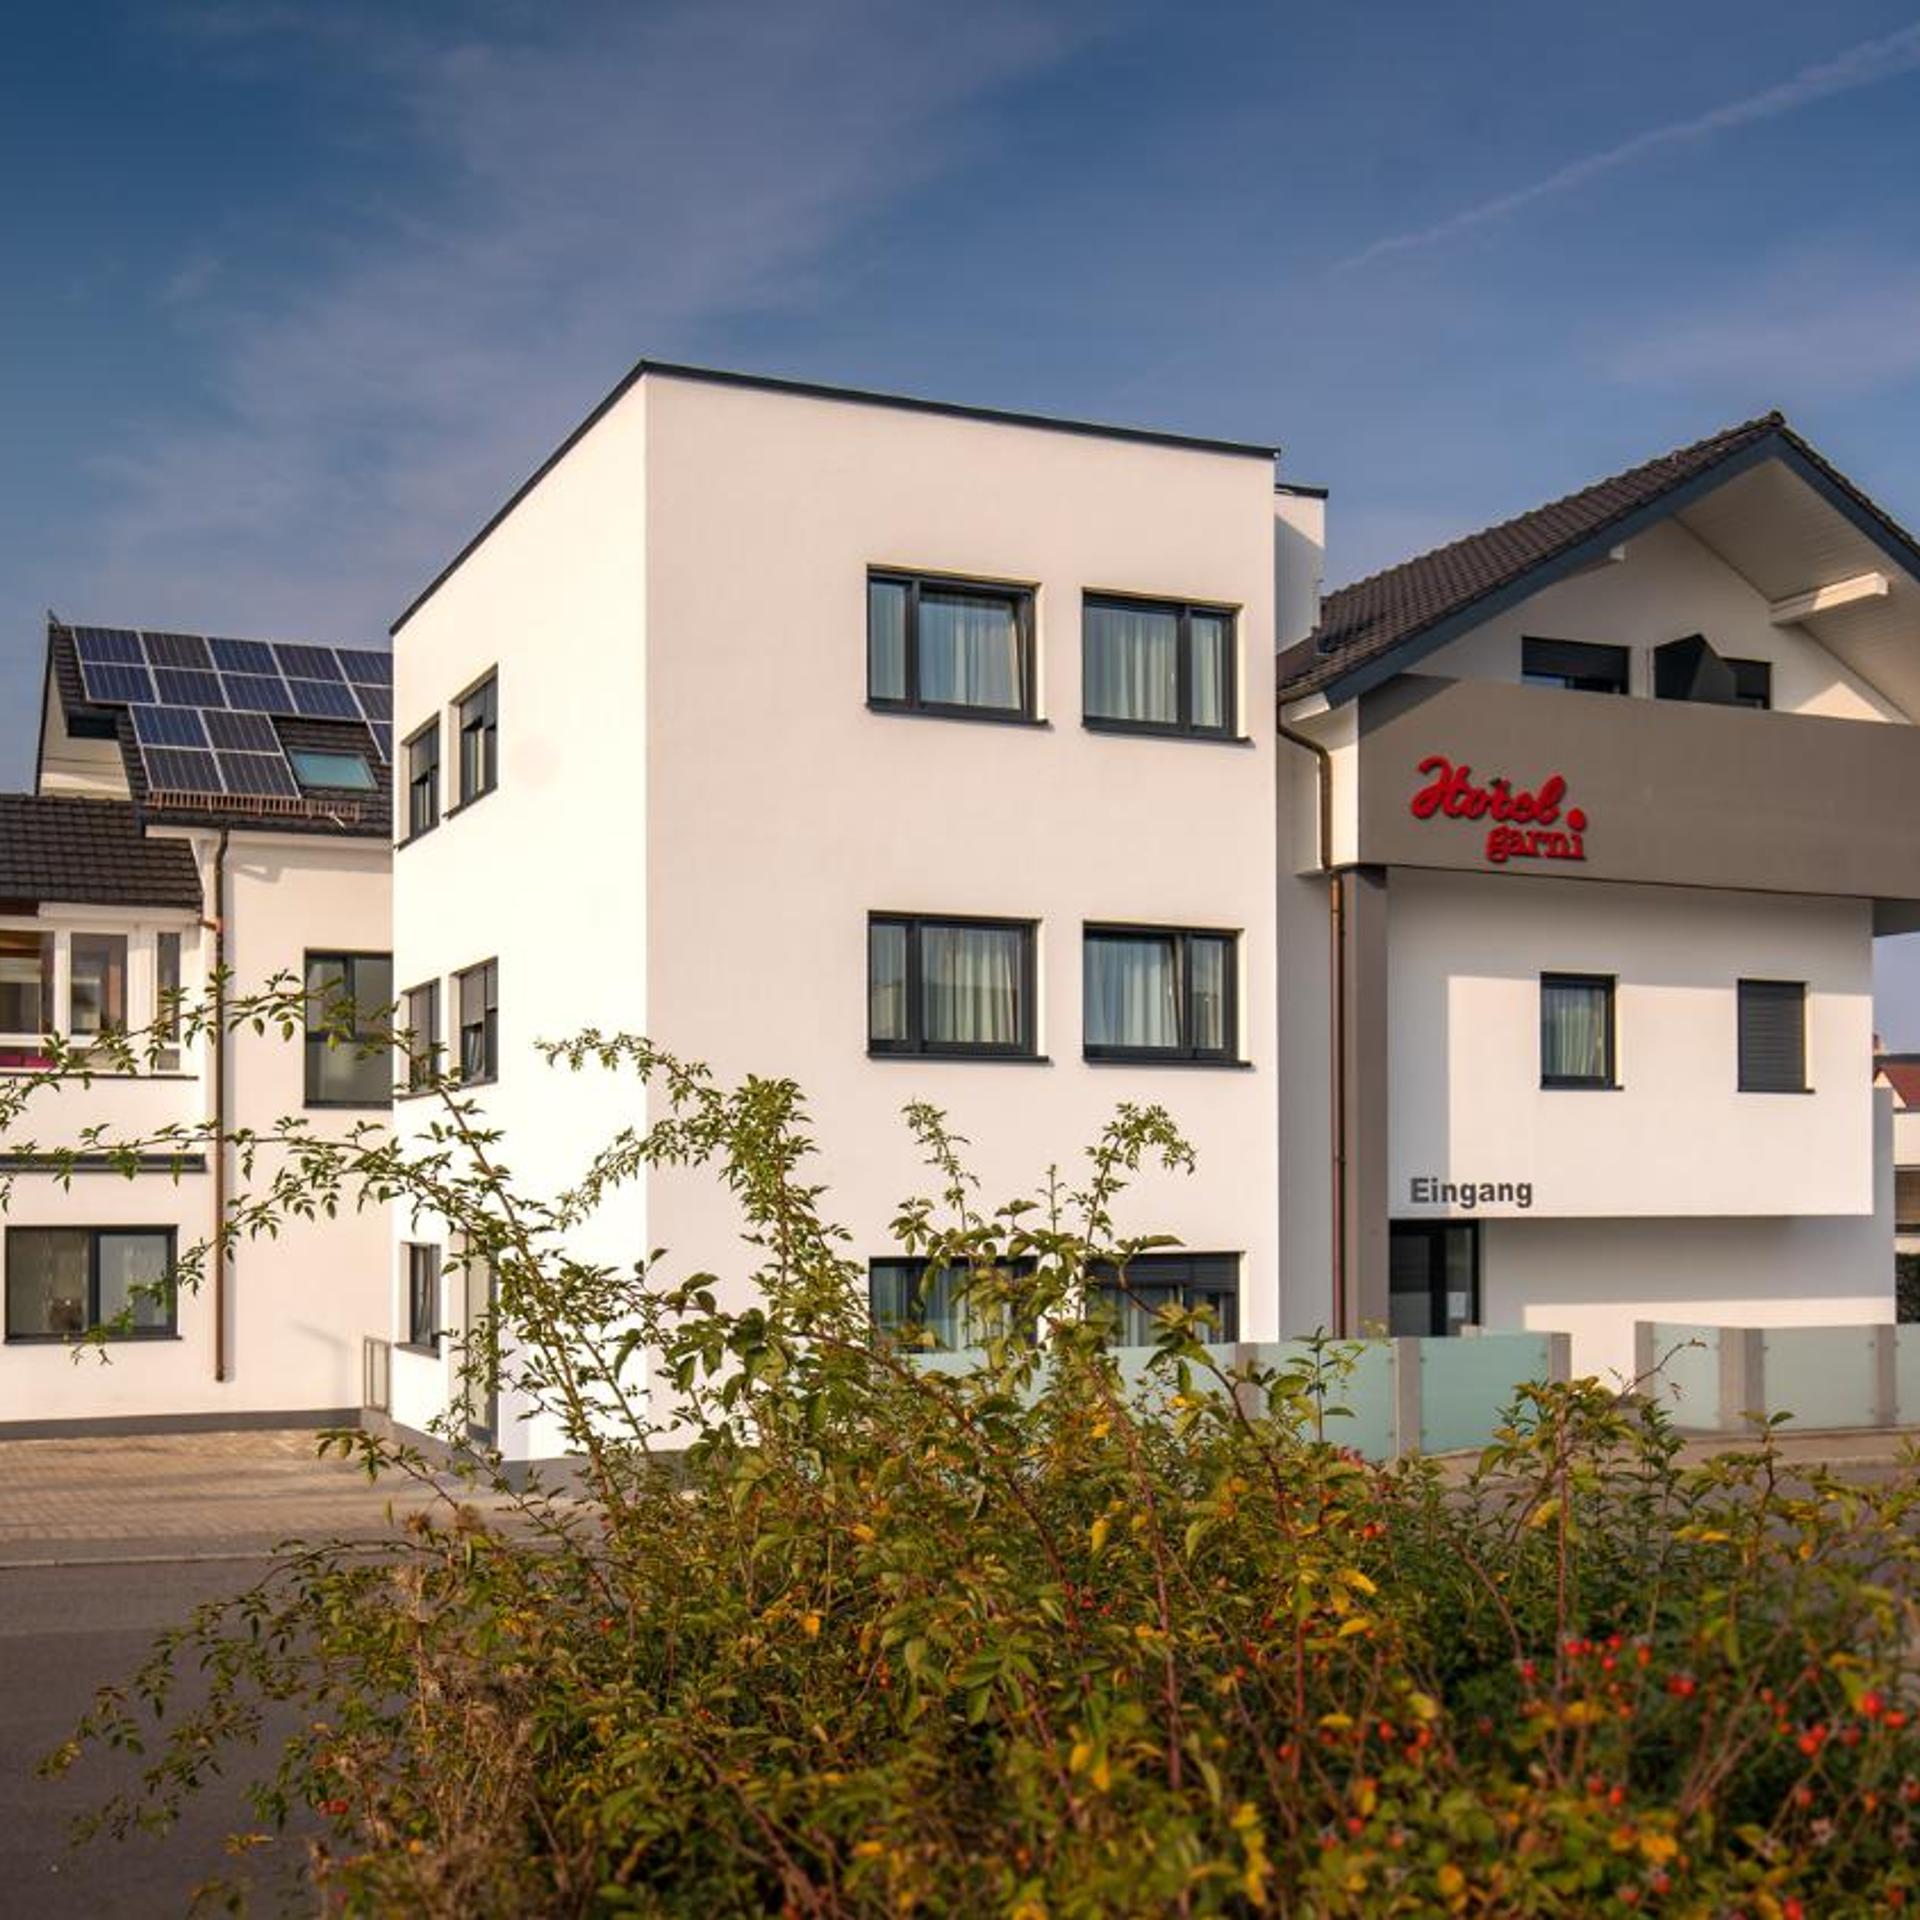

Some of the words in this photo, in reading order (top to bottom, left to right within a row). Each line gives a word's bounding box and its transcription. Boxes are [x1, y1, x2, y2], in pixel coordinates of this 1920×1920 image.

[1411, 756, 1567, 826] Hotel
[1486, 808, 1587, 863] garni
[1410, 1177, 1533, 1209] Eingang
